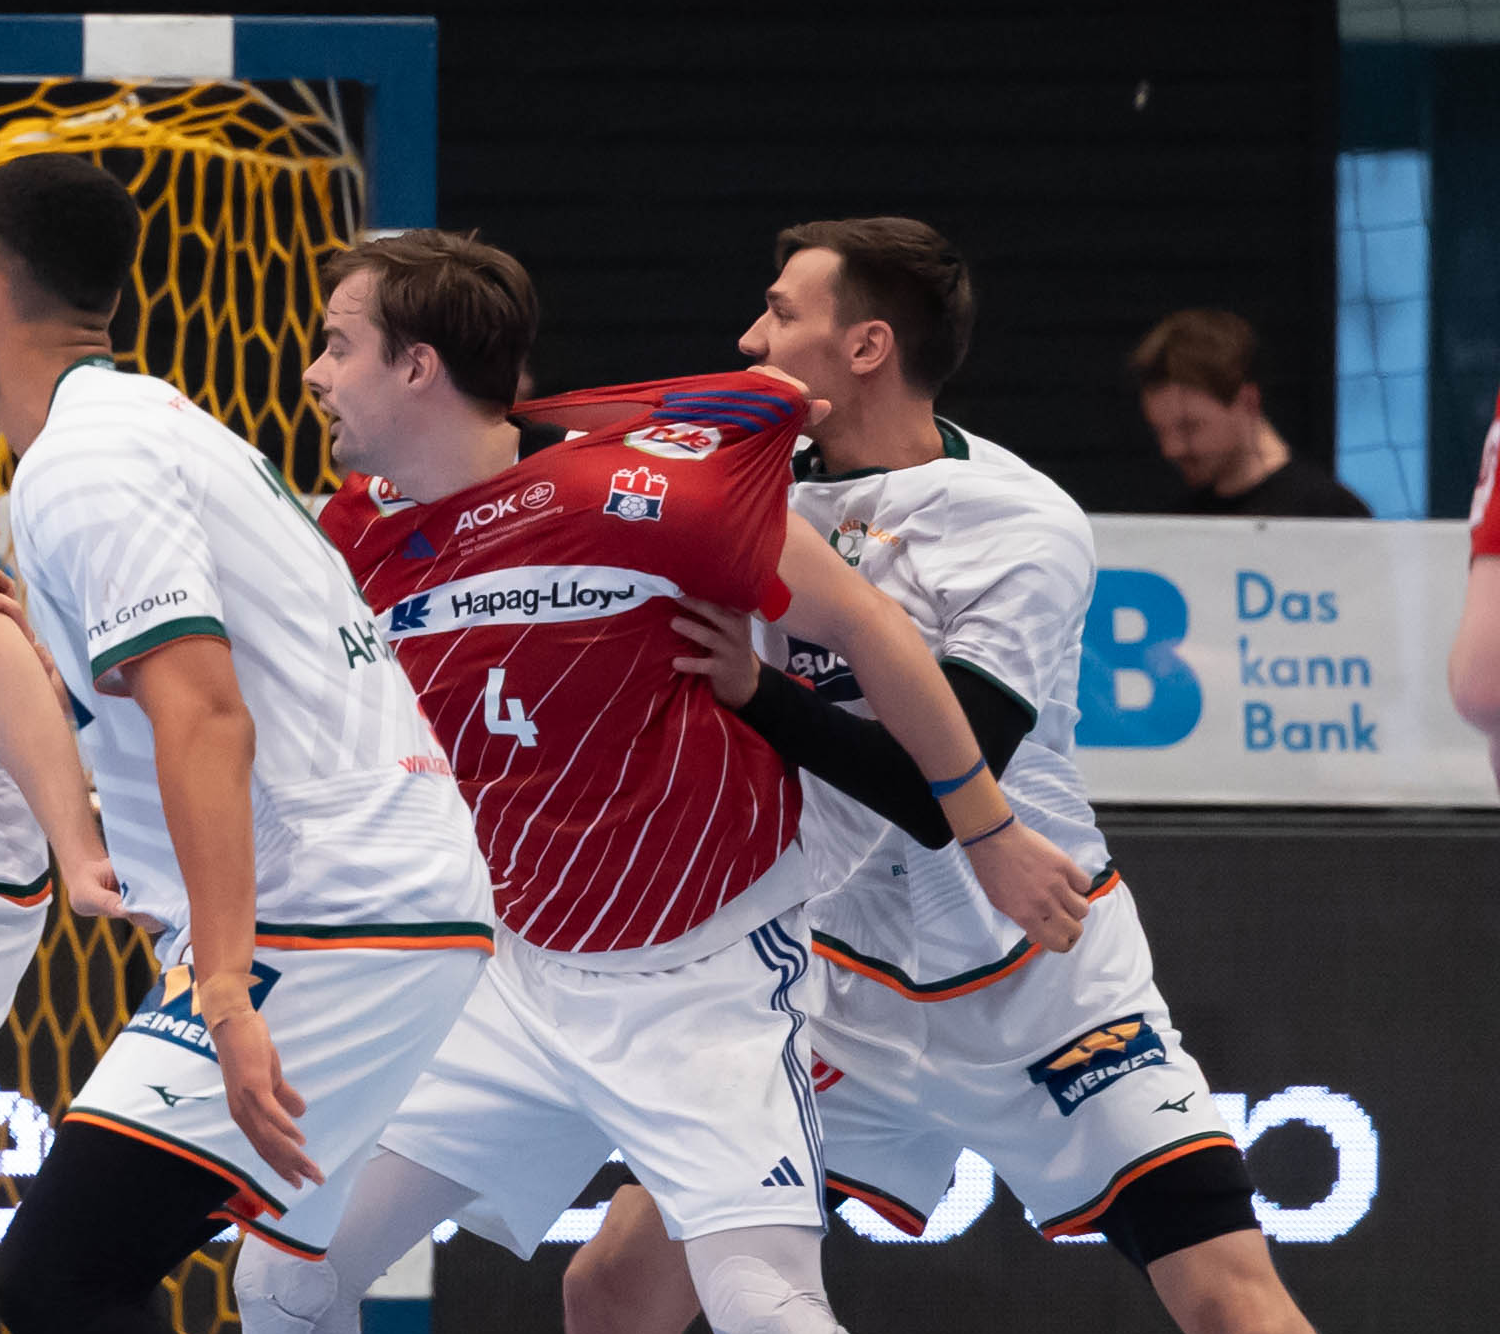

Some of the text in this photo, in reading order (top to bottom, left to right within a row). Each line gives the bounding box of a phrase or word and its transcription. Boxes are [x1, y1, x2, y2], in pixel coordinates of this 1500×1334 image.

[454, 494, 519, 535] AOK
[88, 588, 189, 642] nt.Group
[452, 581, 635, 618] Hapag-Lloyd
[1236, 571, 1338, 622] Das
[1075, 568, 1202, 750] B
[1240, 635, 1372, 688] kann
[484, 668, 539, 747] 4
[1244, 700, 1380, 751] Bank
